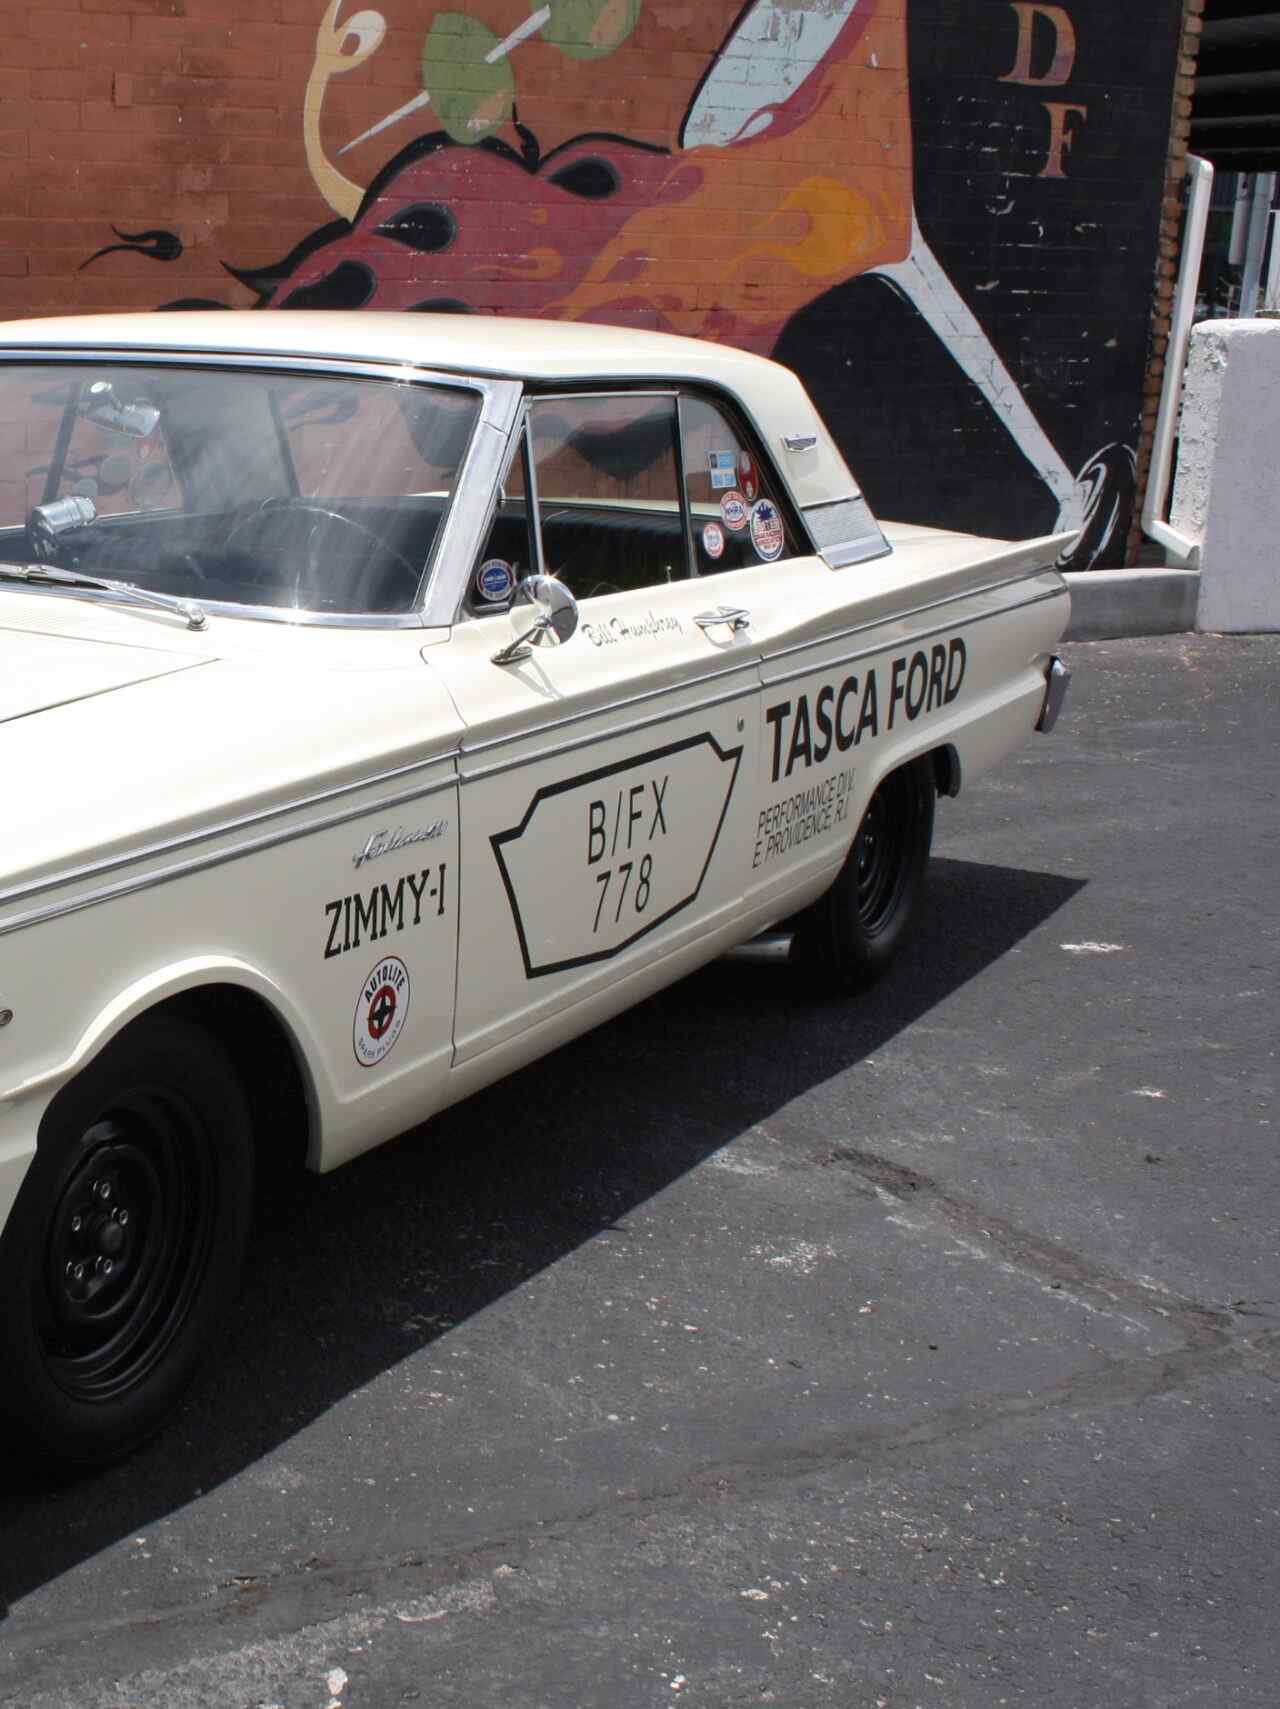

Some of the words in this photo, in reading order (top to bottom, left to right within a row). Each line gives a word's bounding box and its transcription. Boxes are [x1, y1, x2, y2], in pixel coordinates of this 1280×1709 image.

[997, 2, 1077, 86] D
[1037, 102, 1088, 178] F
[766, 669, 878, 783] TASCA
[887, 637, 967, 730] FORD
[587, 775, 669, 865] B/FX
[756, 776, 837, 840] PERFORMANCE
[593, 853, 653, 933] 778
[365, 963, 406, 1003] AUTOLITE
